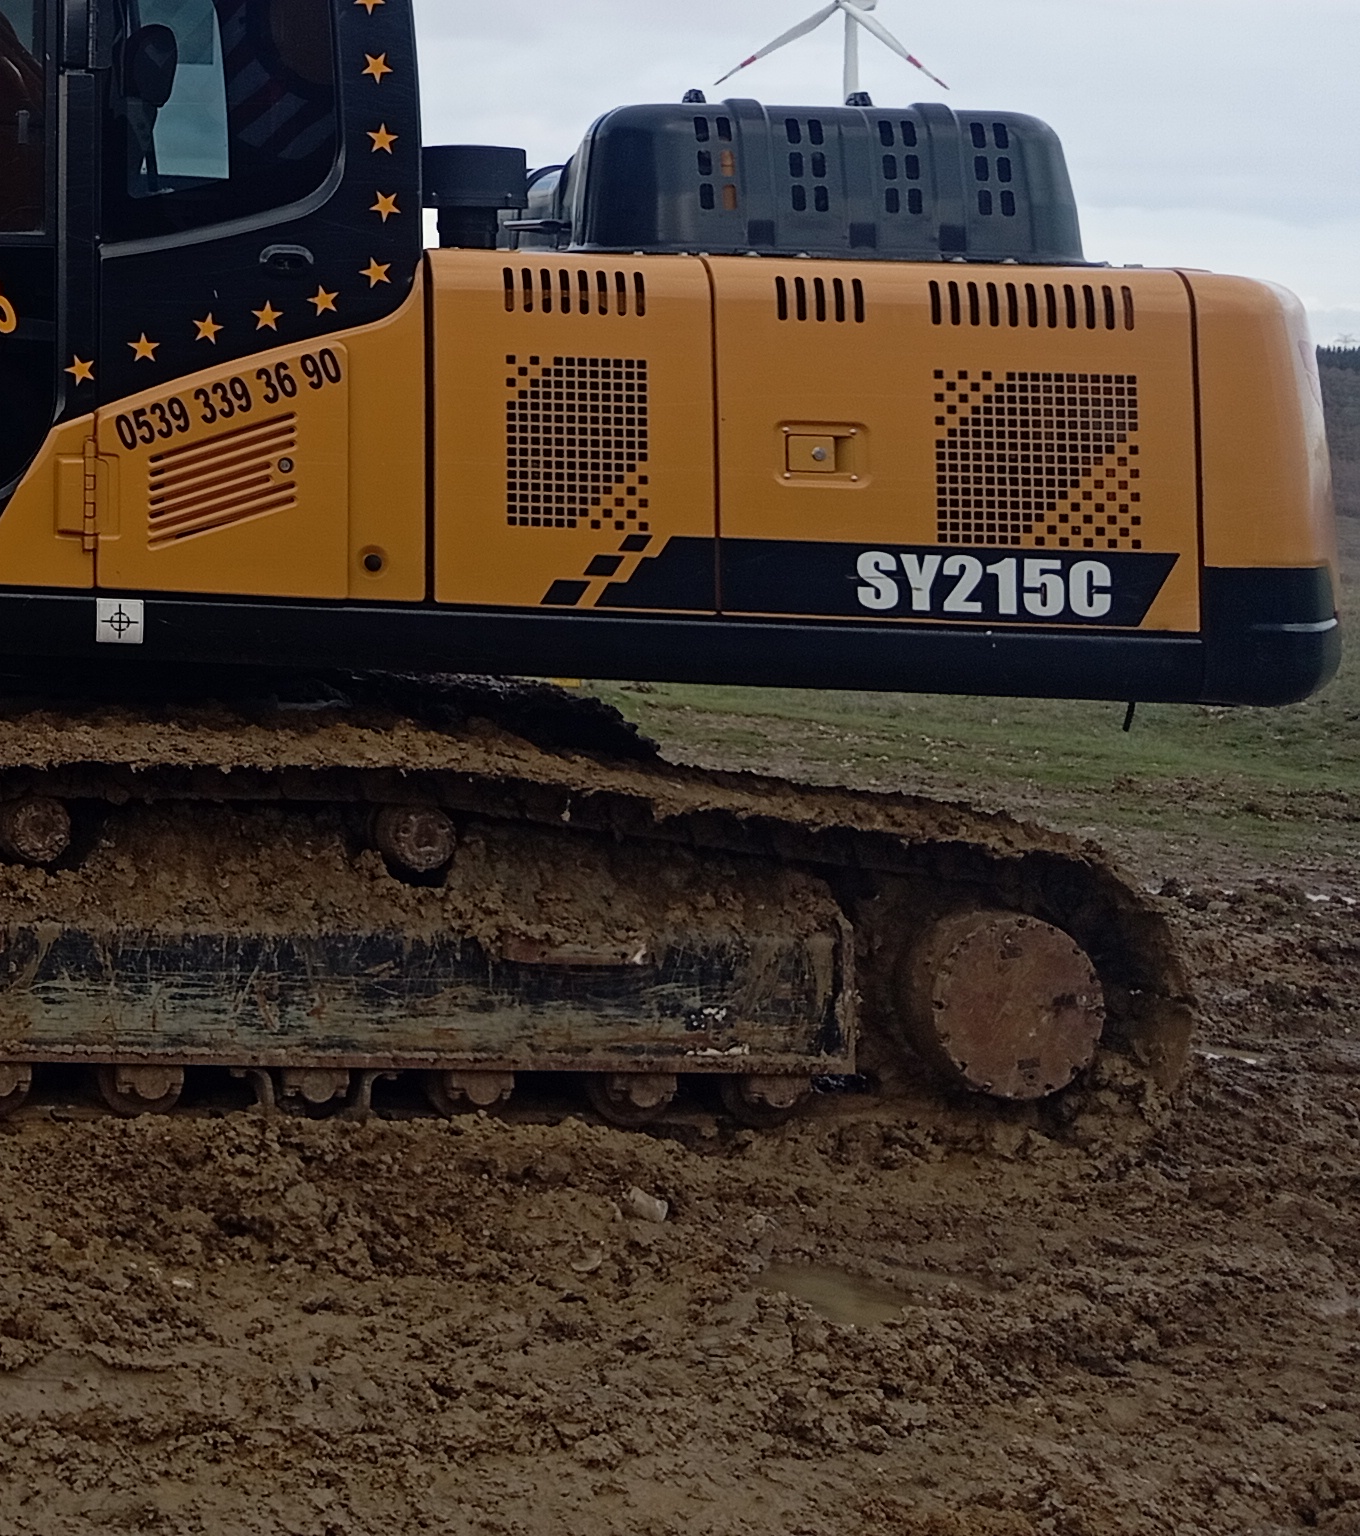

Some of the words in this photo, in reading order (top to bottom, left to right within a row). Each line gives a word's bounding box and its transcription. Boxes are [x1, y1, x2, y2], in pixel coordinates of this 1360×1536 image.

[115, 397, 190, 450] 0539
[193, 376, 252, 424] 339
[256, 361, 298, 404] 36
[300, 347, 342, 390] 90
[857, 550, 1113, 619] SY215C
